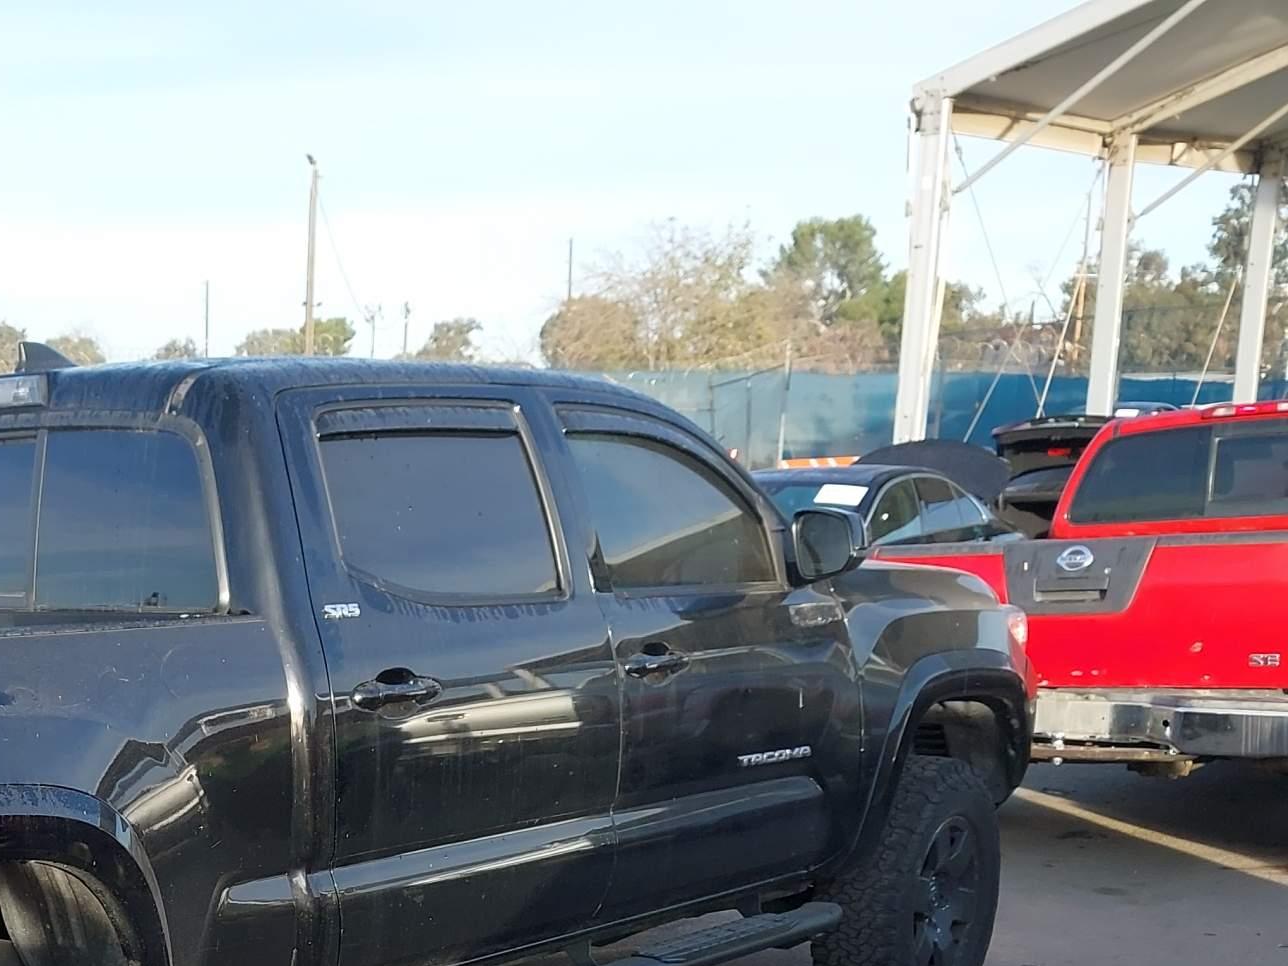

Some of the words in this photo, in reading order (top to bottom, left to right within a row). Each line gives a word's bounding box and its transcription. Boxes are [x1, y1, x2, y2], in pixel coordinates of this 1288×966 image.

[322, 602, 361, 619] SR5
[1248, 652, 1281, 667] SE
[736, 745, 812, 767] TACOMA
